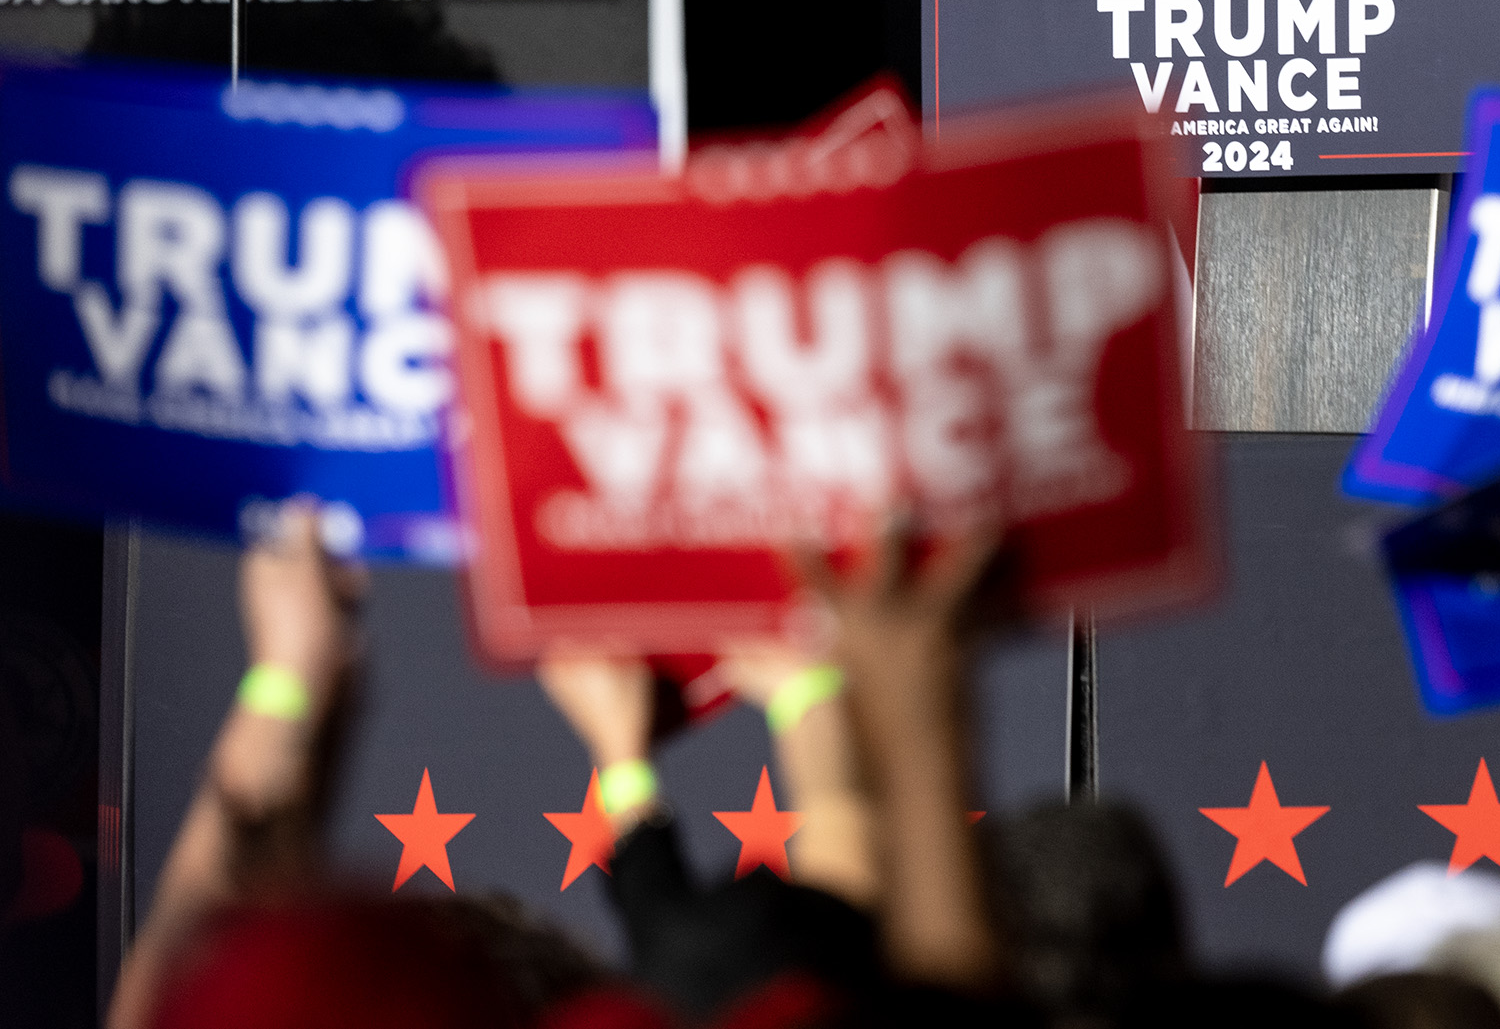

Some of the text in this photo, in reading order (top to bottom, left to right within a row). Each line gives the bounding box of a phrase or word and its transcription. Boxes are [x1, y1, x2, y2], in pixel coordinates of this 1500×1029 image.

[1130, 57, 1362, 113] VANCE
[1171, 116, 1378, 136] AMERICA GREAT AGAIN!
[1202, 140, 1294, 172] 2024
[72, 282, 456, 417] VANC
[465, 214, 1170, 427] TRUMP
[562, 367, 1105, 517] VANCE
